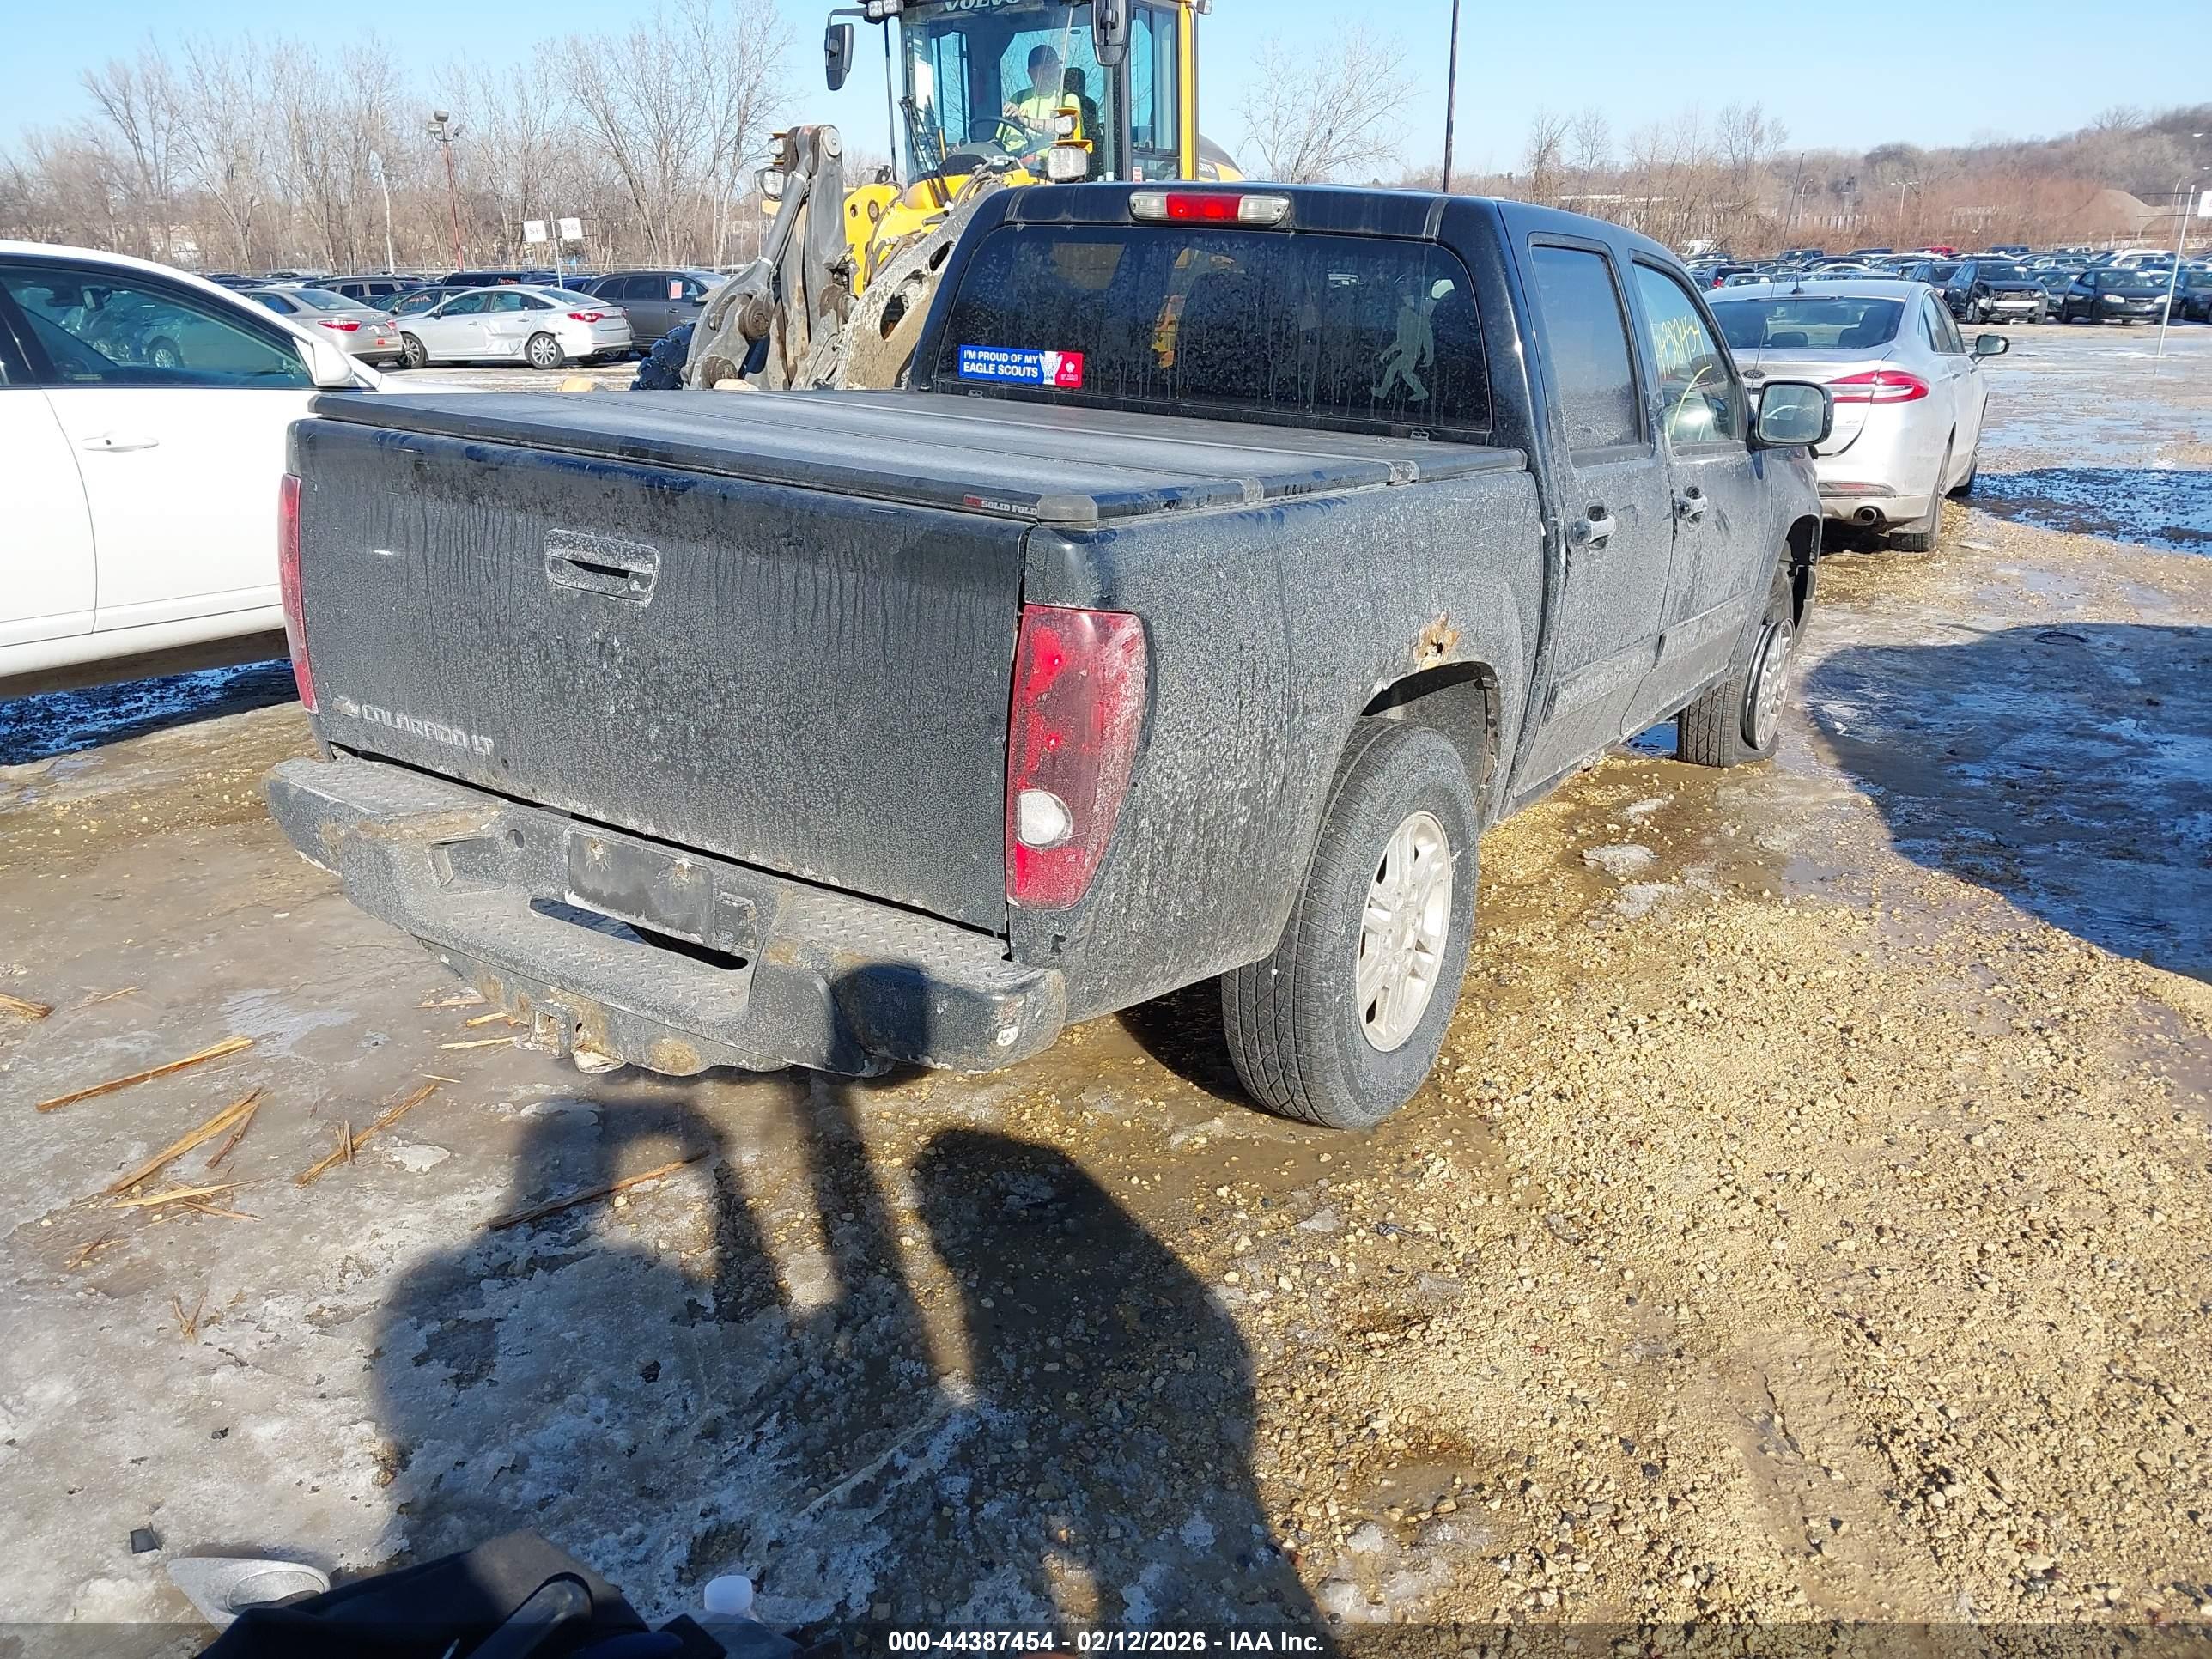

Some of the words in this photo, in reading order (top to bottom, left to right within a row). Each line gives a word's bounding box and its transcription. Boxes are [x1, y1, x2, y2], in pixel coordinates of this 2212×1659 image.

[963, 349, 976, 359] I'M
[978, 350, 1008, 362] PROUD
[1011, 353, 1023, 362] OF
[1024, 355, 1038, 364] MY
[963, 362, 995, 374] EAGLE
[998, 364, 1038, 378] SCOUTS
[981, 500, 1010, 512] SOLID
[1012, 505, 1038, 515] FOLD
[361, 704, 467, 749] COLORADO
[471, 734, 495, 756] LT
